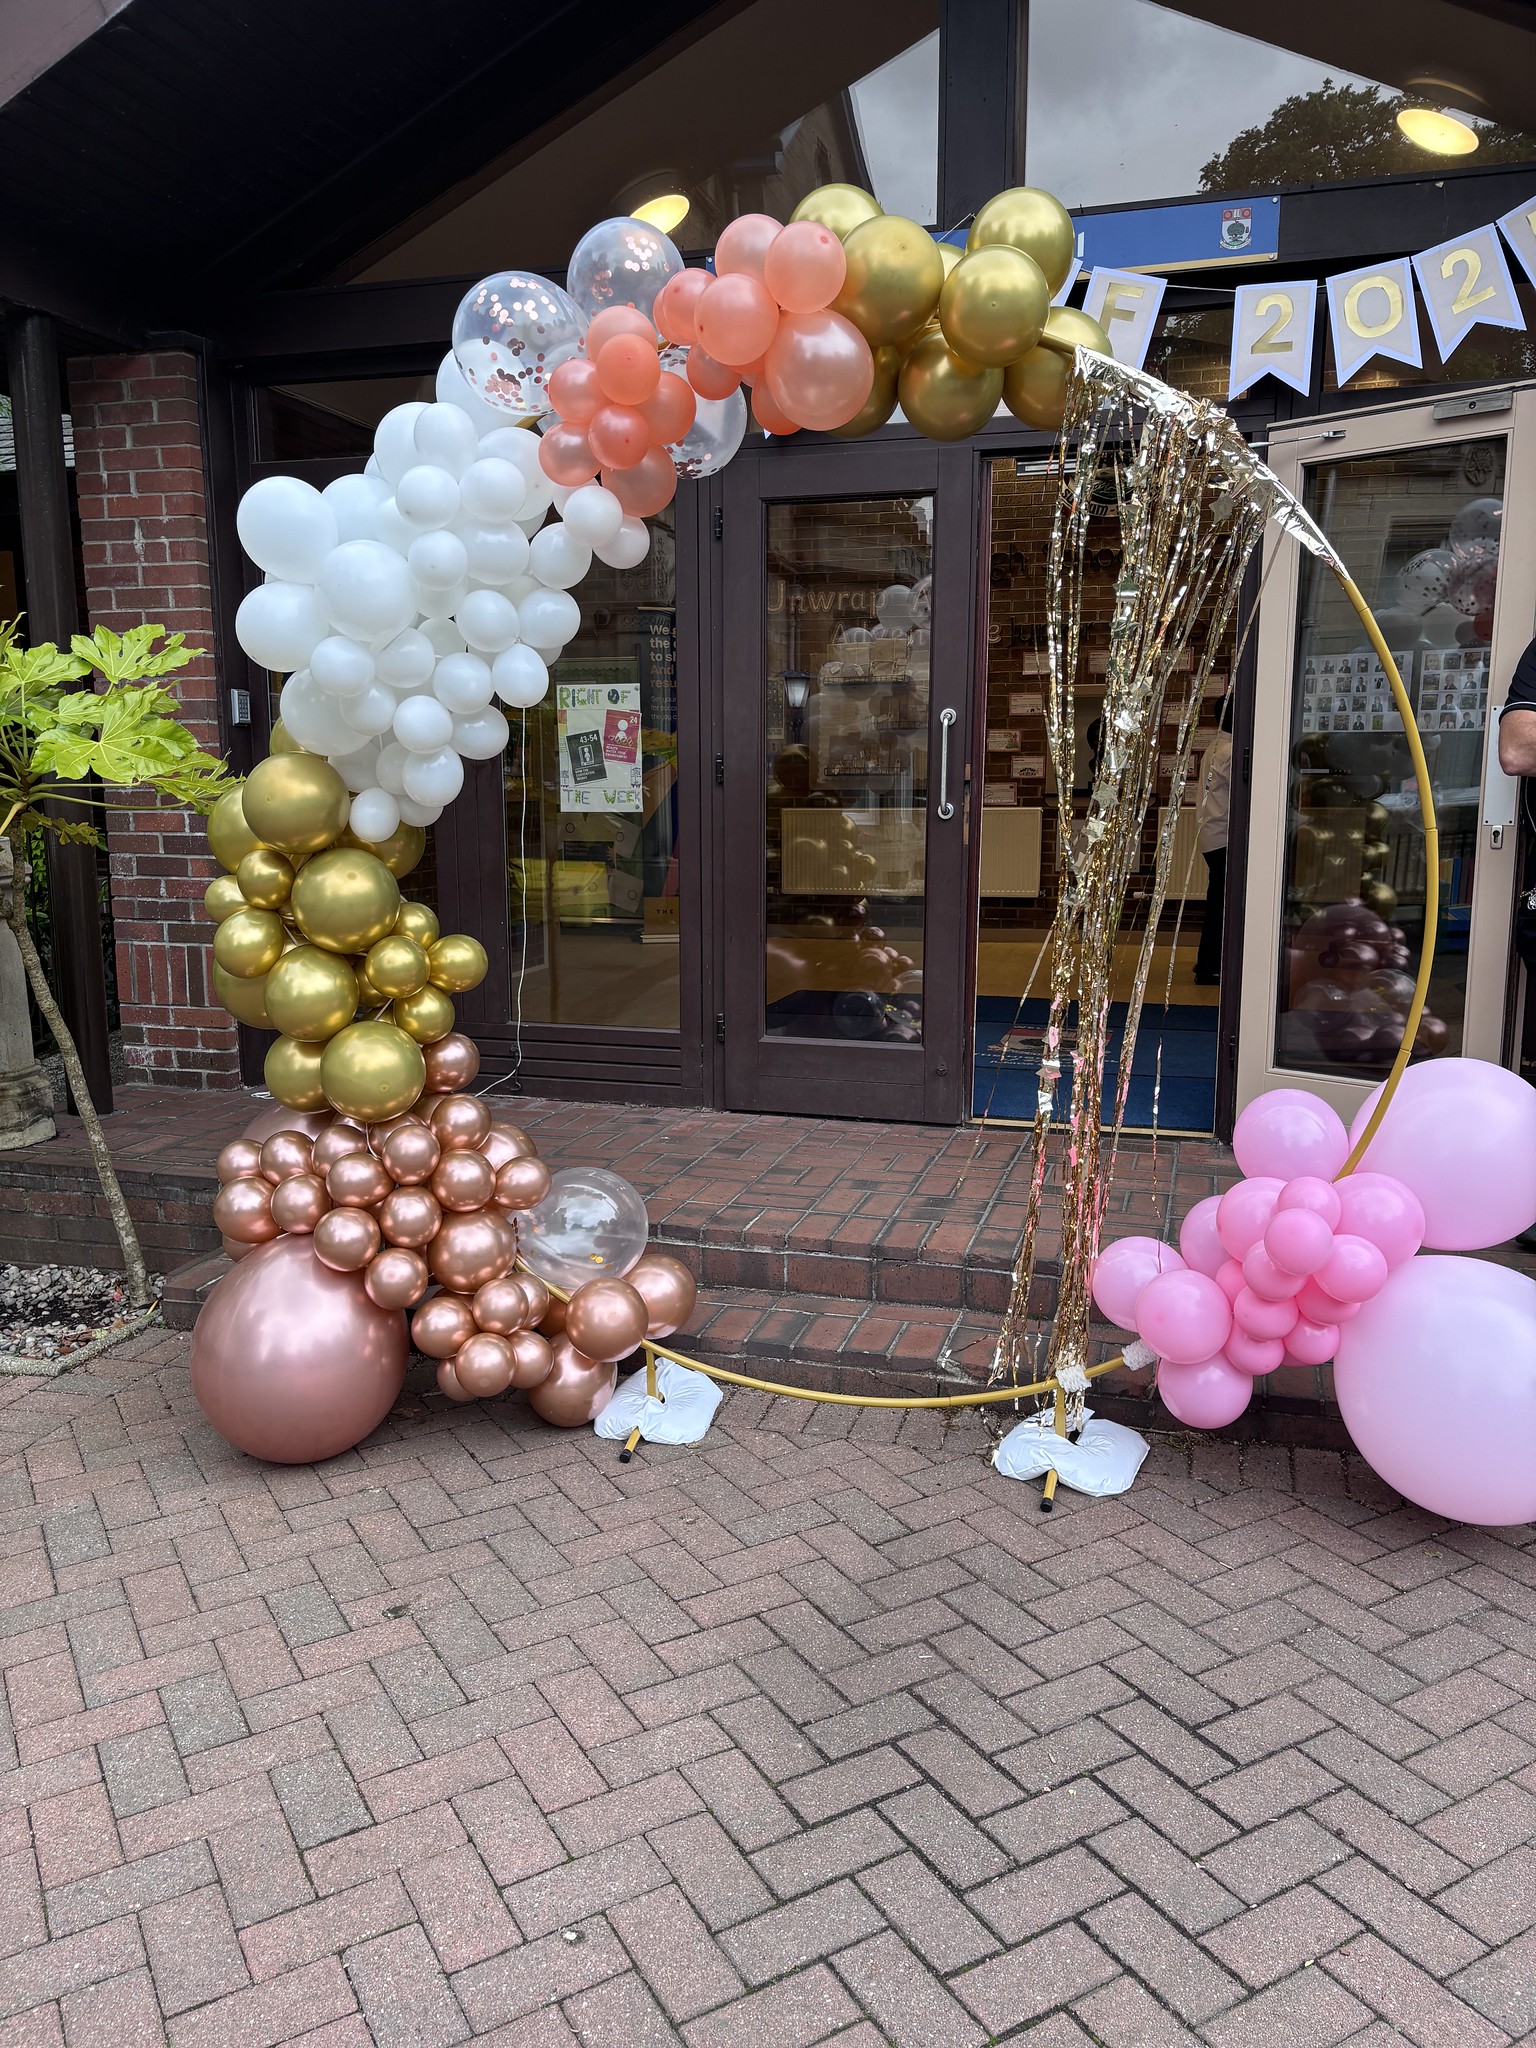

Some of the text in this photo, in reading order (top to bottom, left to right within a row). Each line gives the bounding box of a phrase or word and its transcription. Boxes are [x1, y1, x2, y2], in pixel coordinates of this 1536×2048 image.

[1099, 209, 1536, 355] F 202
[767, 580, 888, 619] Unwrap
[649, 624, 670, 635] We
[649, 637, 671, 649] the
[649, 651, 663, 662] to
[650, 664, 674, 675] And
[558, 686, 632, 709] RIGHT OF
[629, 715, 638, 725] 24
[579, 733, 598, 744] 43-54
[562, 788, 640, 805] THE WEEK
